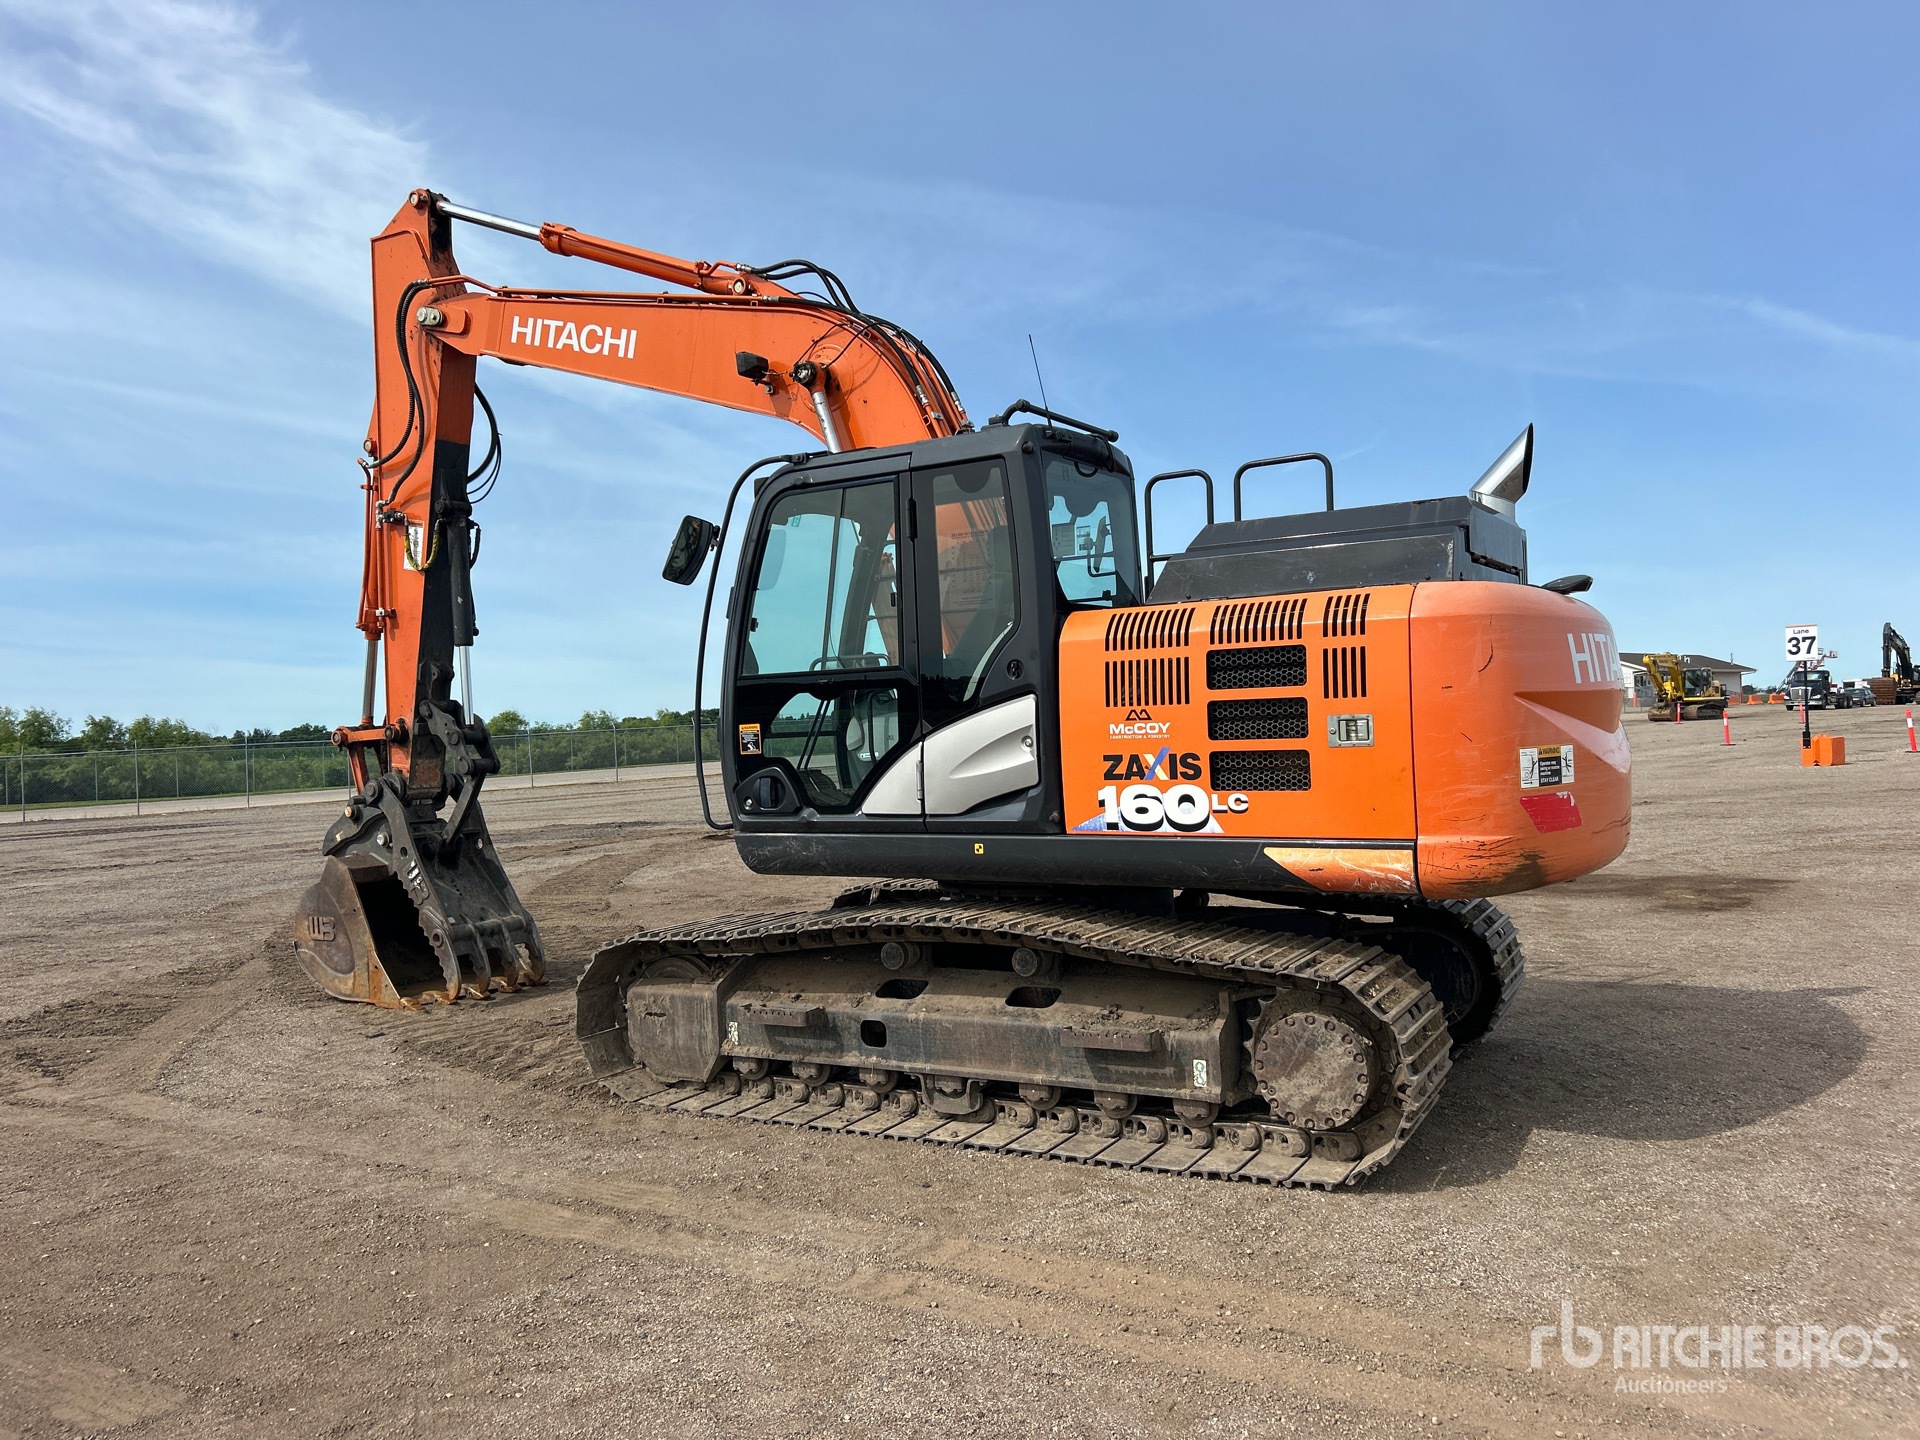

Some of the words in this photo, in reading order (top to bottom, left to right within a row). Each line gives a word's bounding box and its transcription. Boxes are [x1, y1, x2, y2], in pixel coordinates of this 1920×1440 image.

[511, 315, 637, 359] HITACHI
[1567, 633, 1623, 683] HITA
[1787, 636, 1816, 655] 37
[1109, 722, 1170, 734] McCOY
[1103, 747, 1202, 781] ZAXIS
